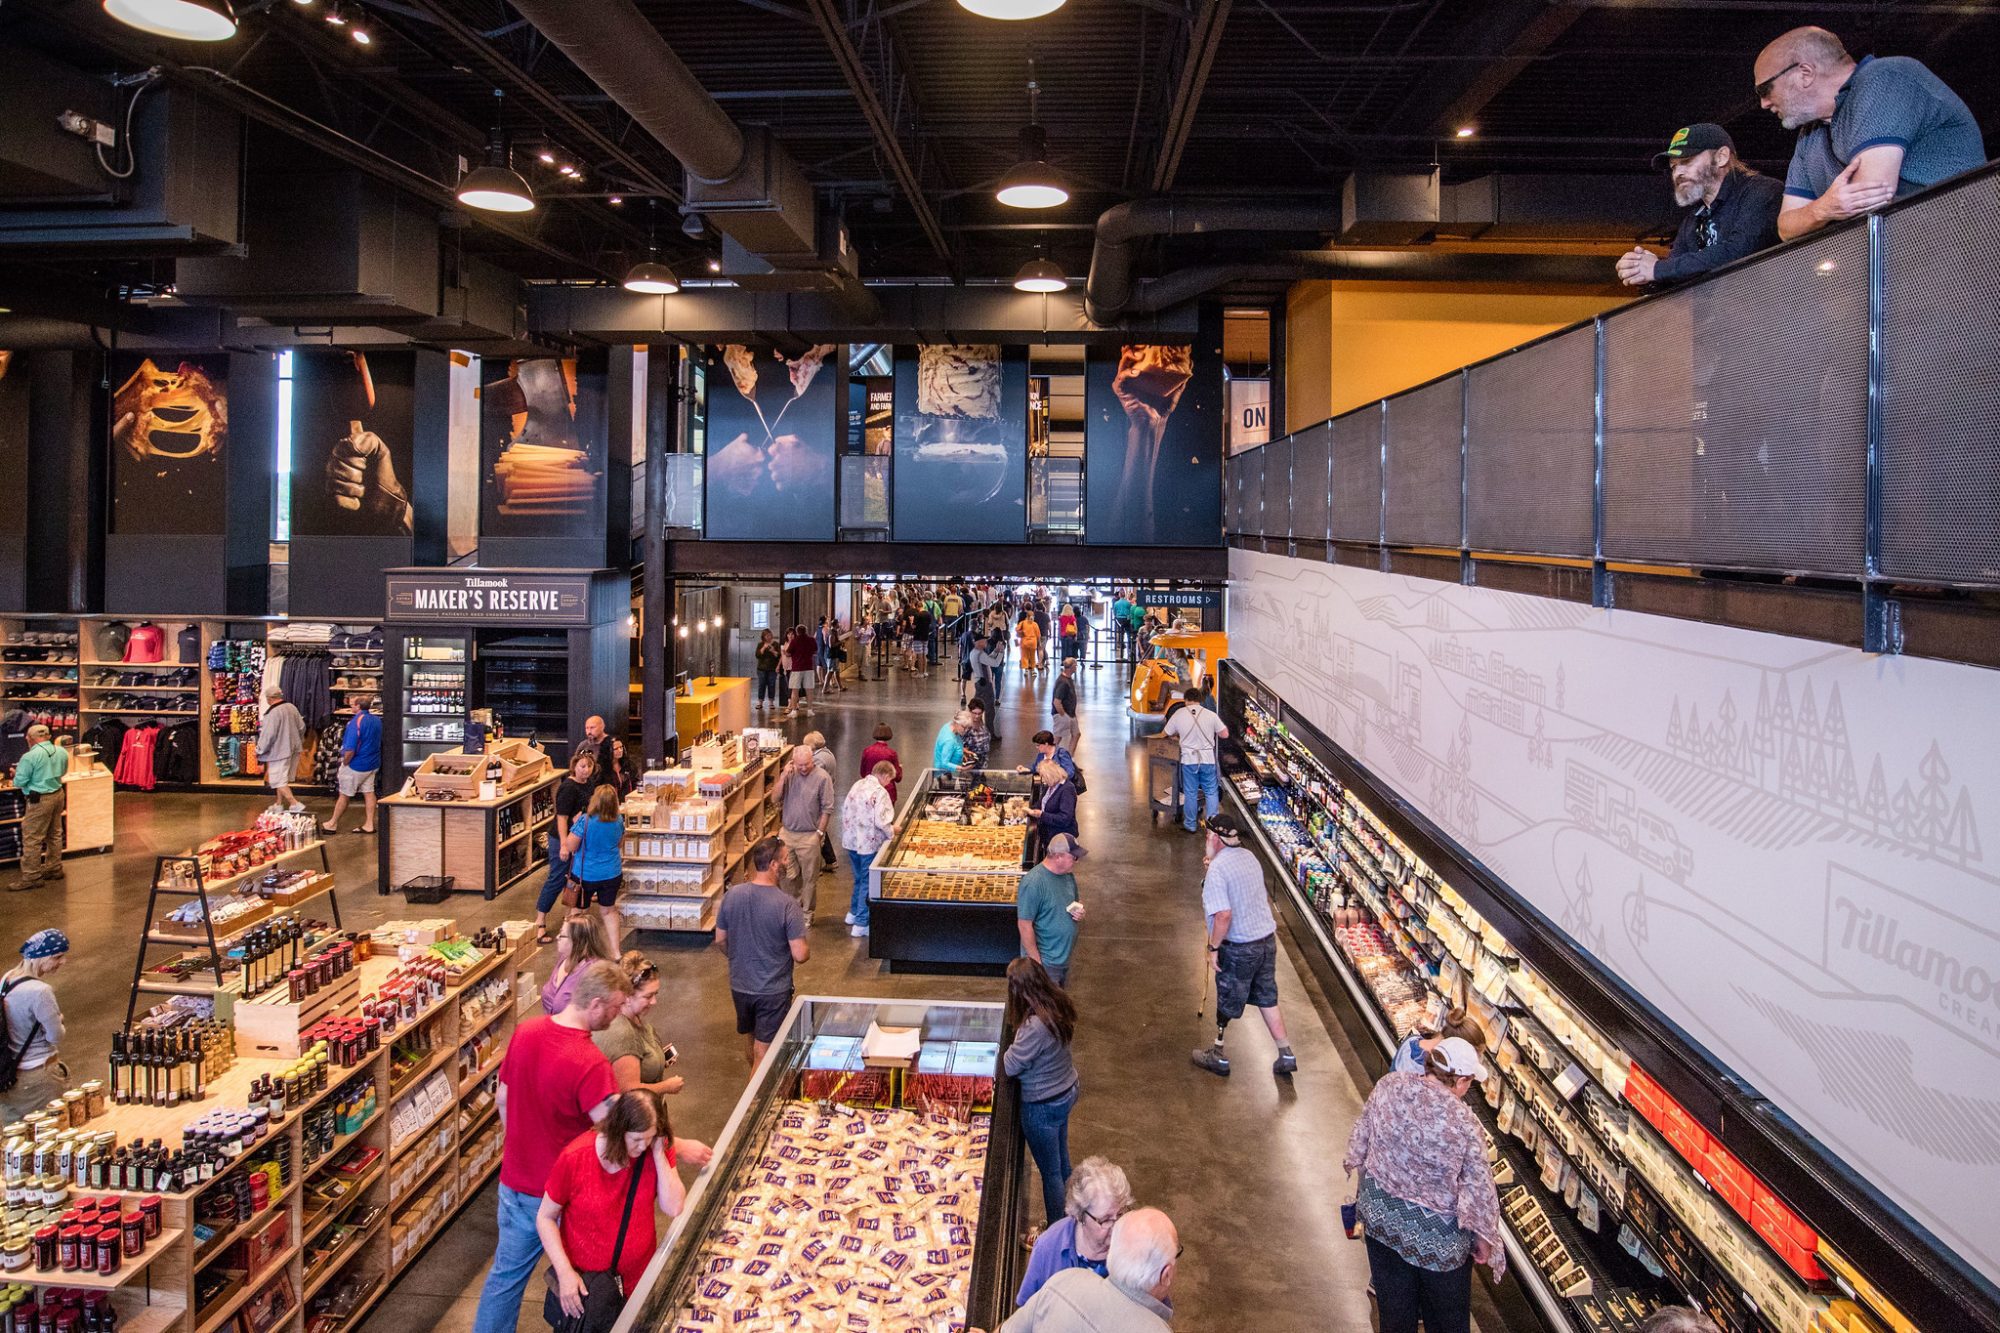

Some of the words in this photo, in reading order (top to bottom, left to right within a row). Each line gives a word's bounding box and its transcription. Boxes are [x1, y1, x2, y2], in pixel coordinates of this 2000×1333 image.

[870, 402, 881, 411] AND
[1243, 406, 1266, 429] ON
[465, 577, 508, 588] Tillamook
[415, 589, 483, 610] MAKER'S
[489, 590, 559, 611] RESERVE
[1145, 594, 1202, 604] RESTROOMS
[1834, 895, 2000, 1012] Tillamo
